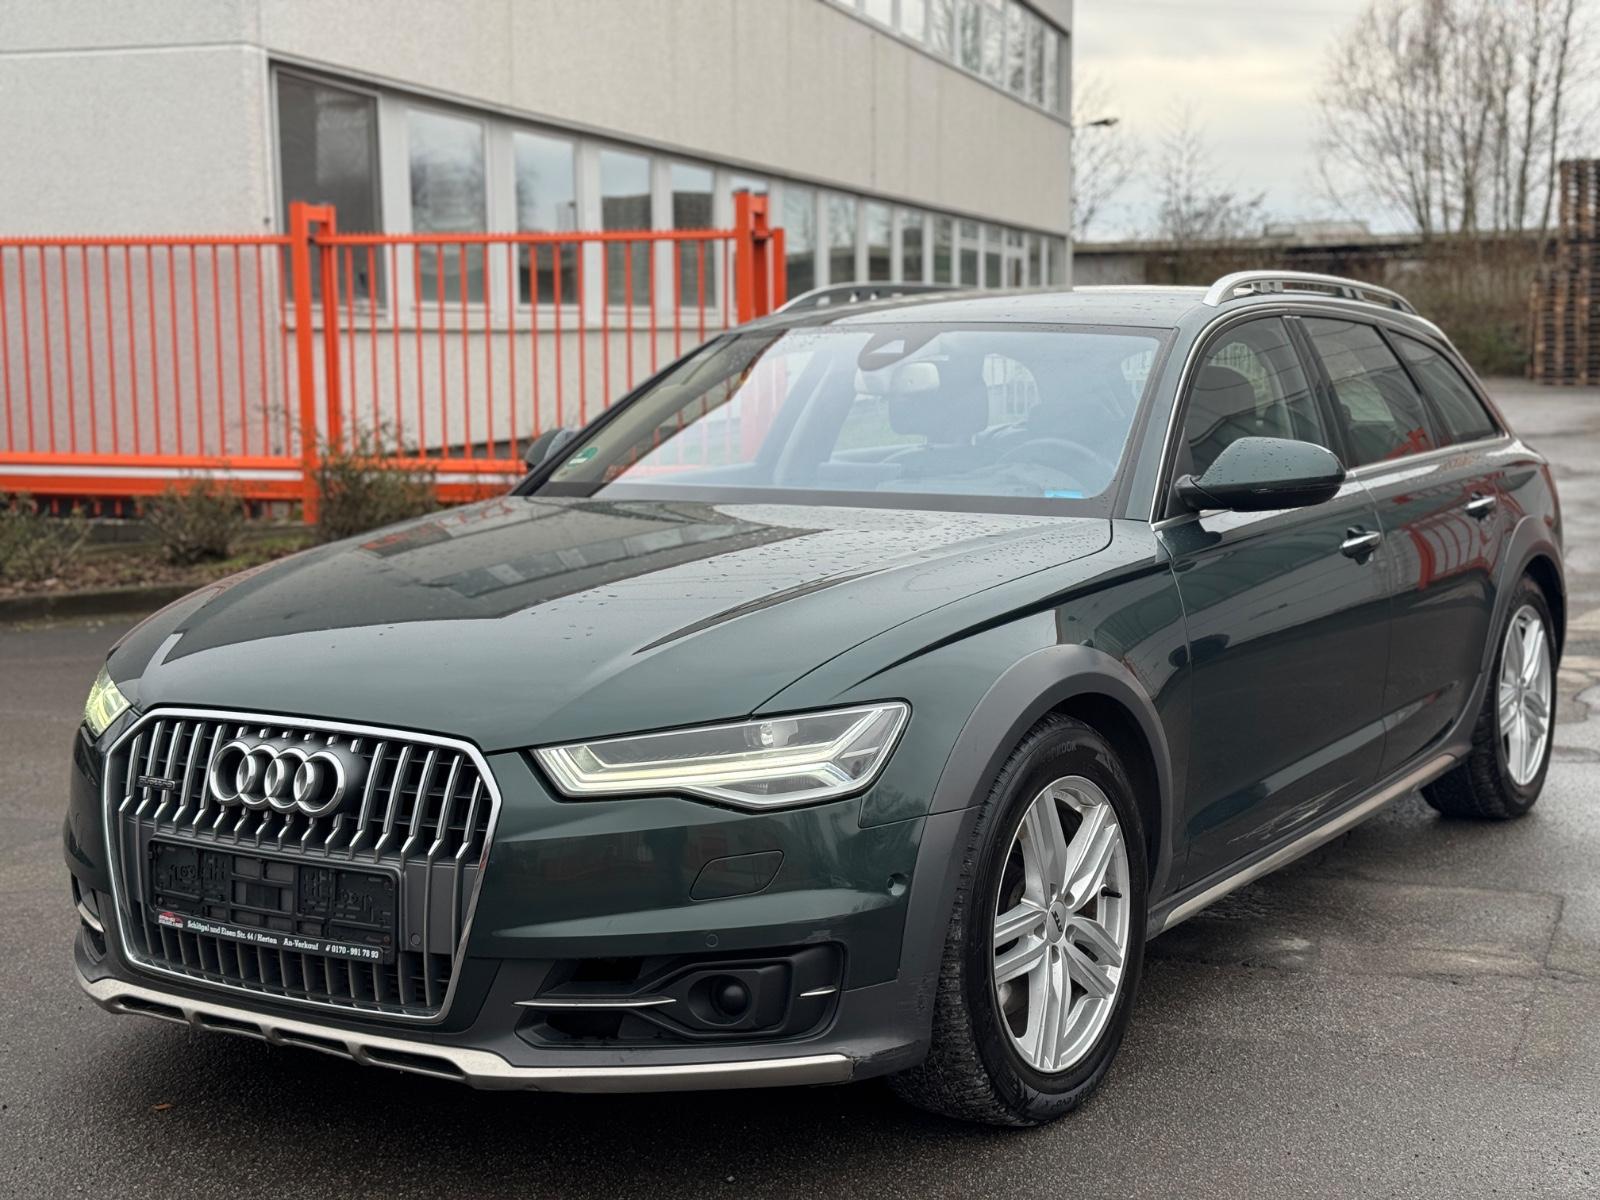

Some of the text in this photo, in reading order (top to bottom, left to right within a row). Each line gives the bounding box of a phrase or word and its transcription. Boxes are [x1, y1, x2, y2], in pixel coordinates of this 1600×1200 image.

[210, 926, 221, 934] und
[247, 932, 254, 941] 44
[257, 933, 278, 944] Herten
[331, 944, 347, 954] 0170
